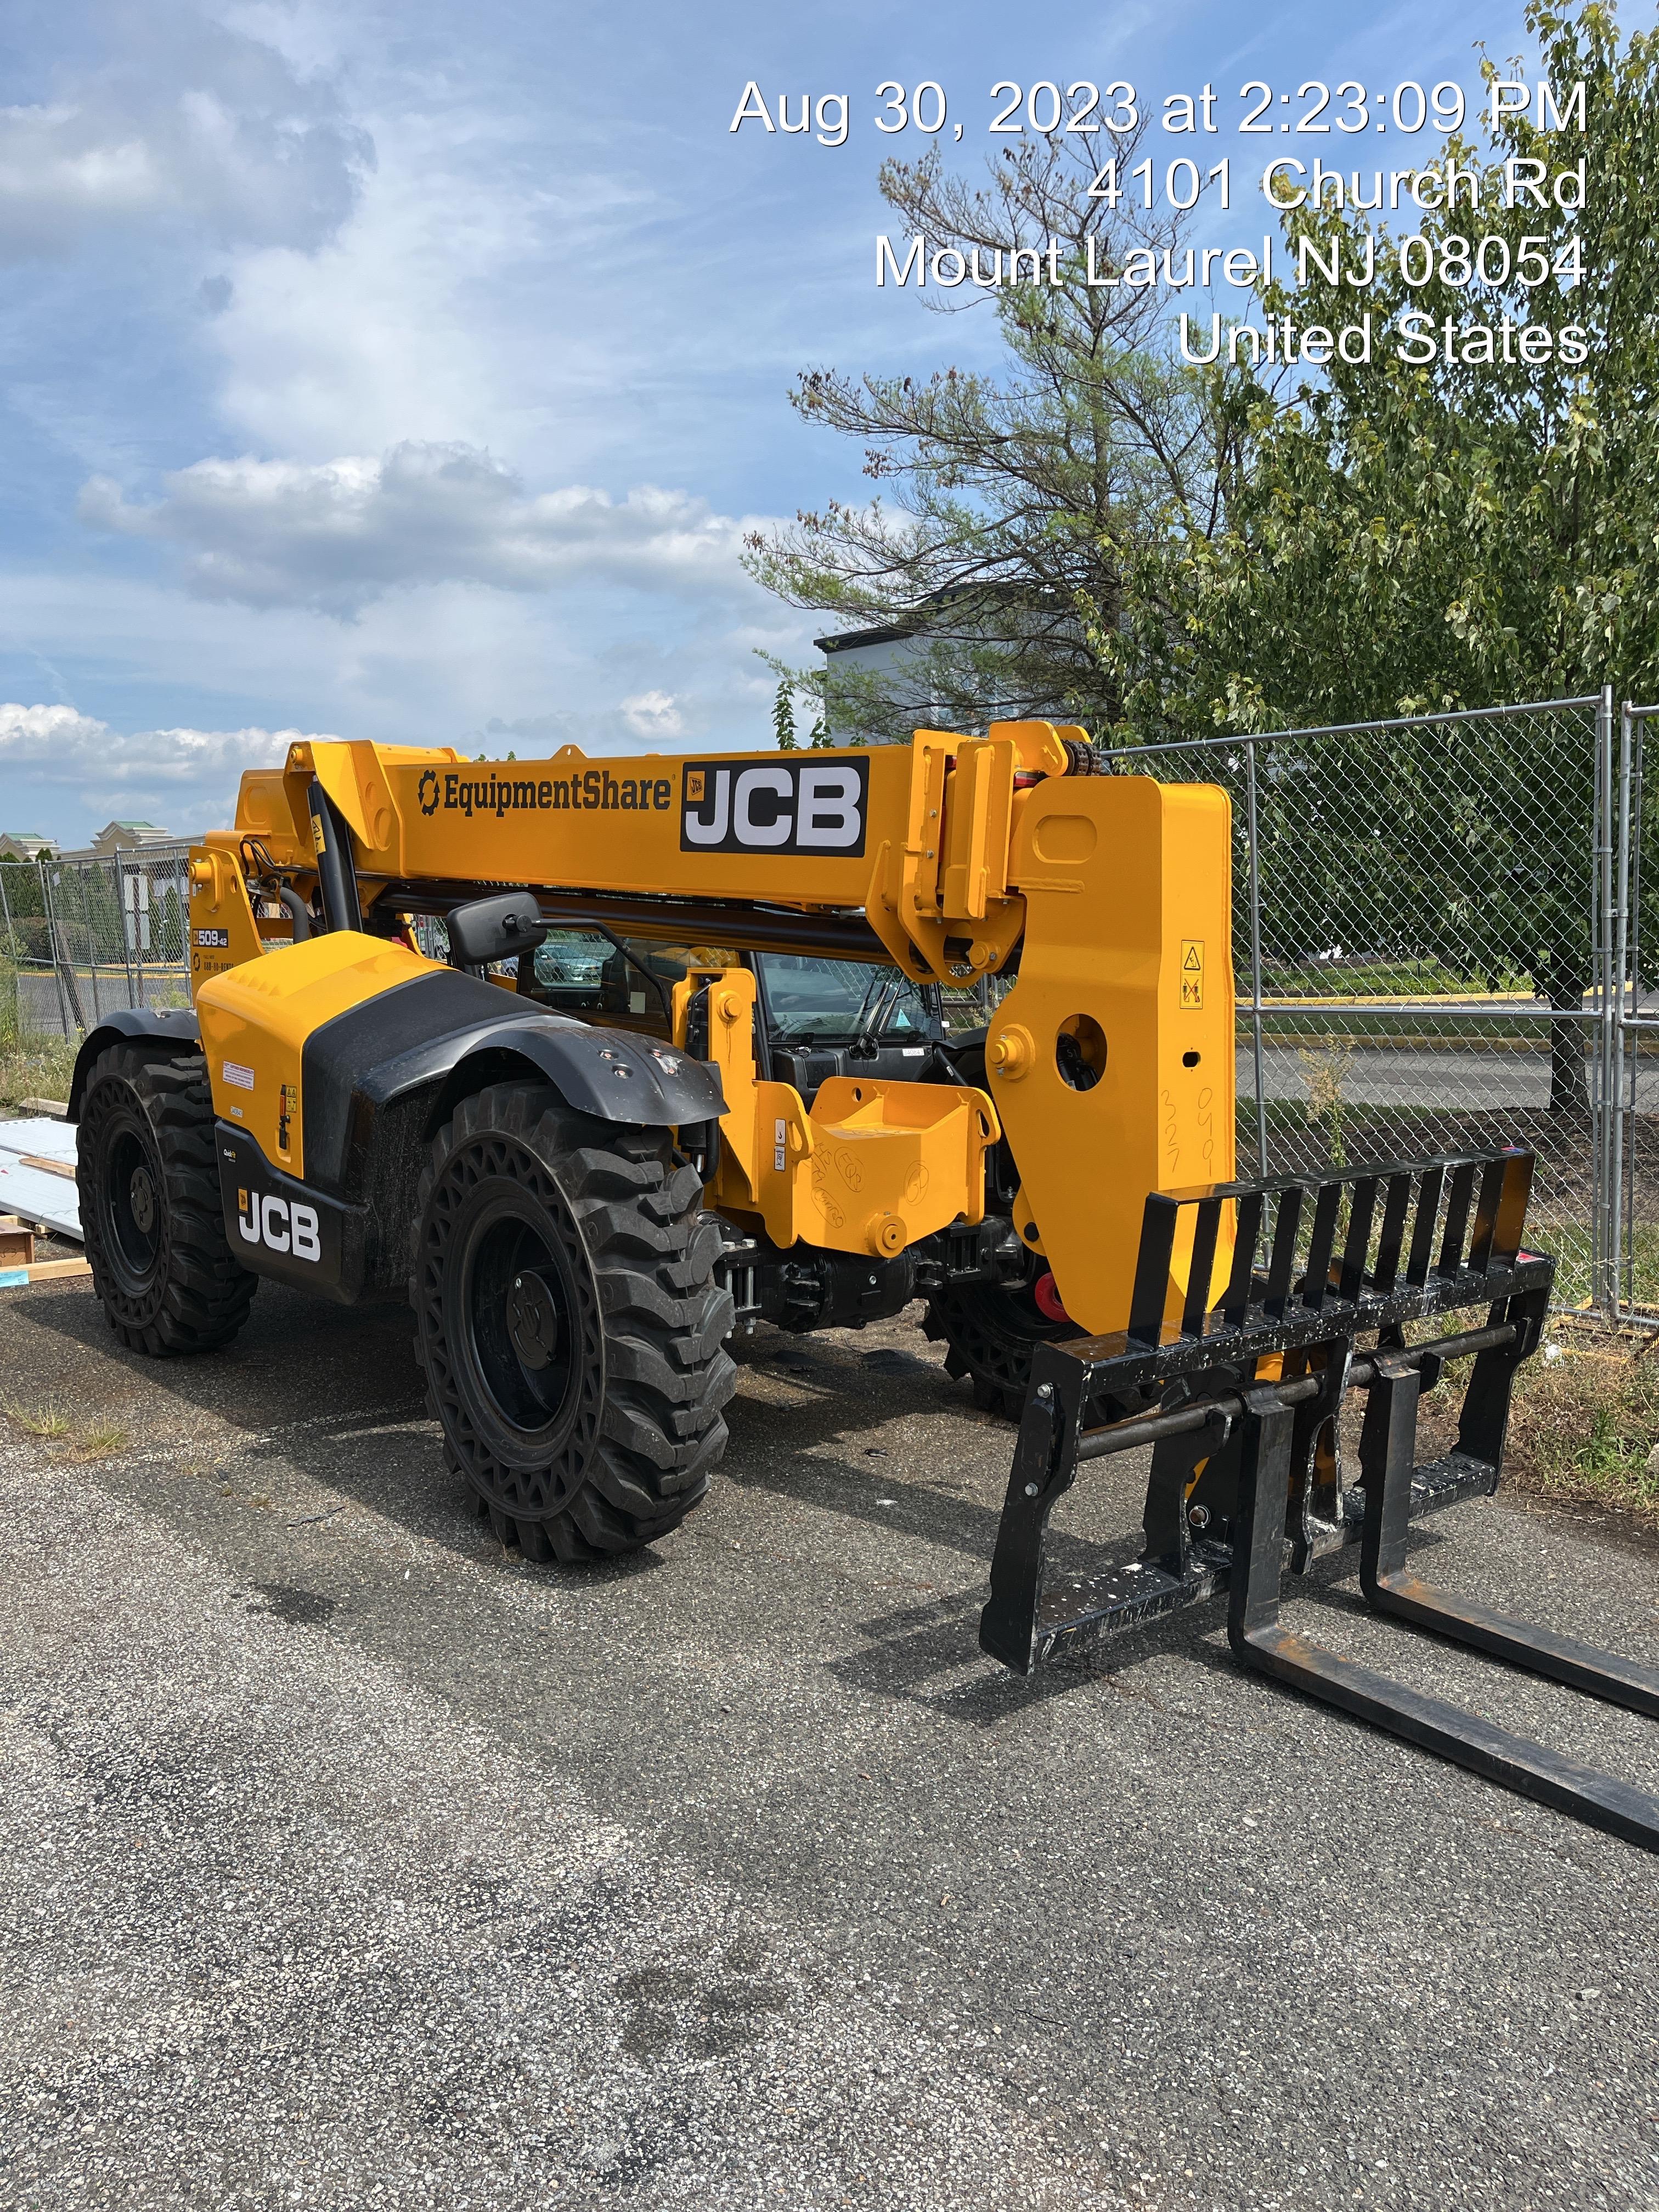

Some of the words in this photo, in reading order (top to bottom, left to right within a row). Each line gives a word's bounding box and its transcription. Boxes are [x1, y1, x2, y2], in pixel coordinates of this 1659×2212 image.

[444, 770, 671, 817] EquipmentShare
[686, 766, 861, 847] JCB
[239, 1192, 321, 1262] JCB
